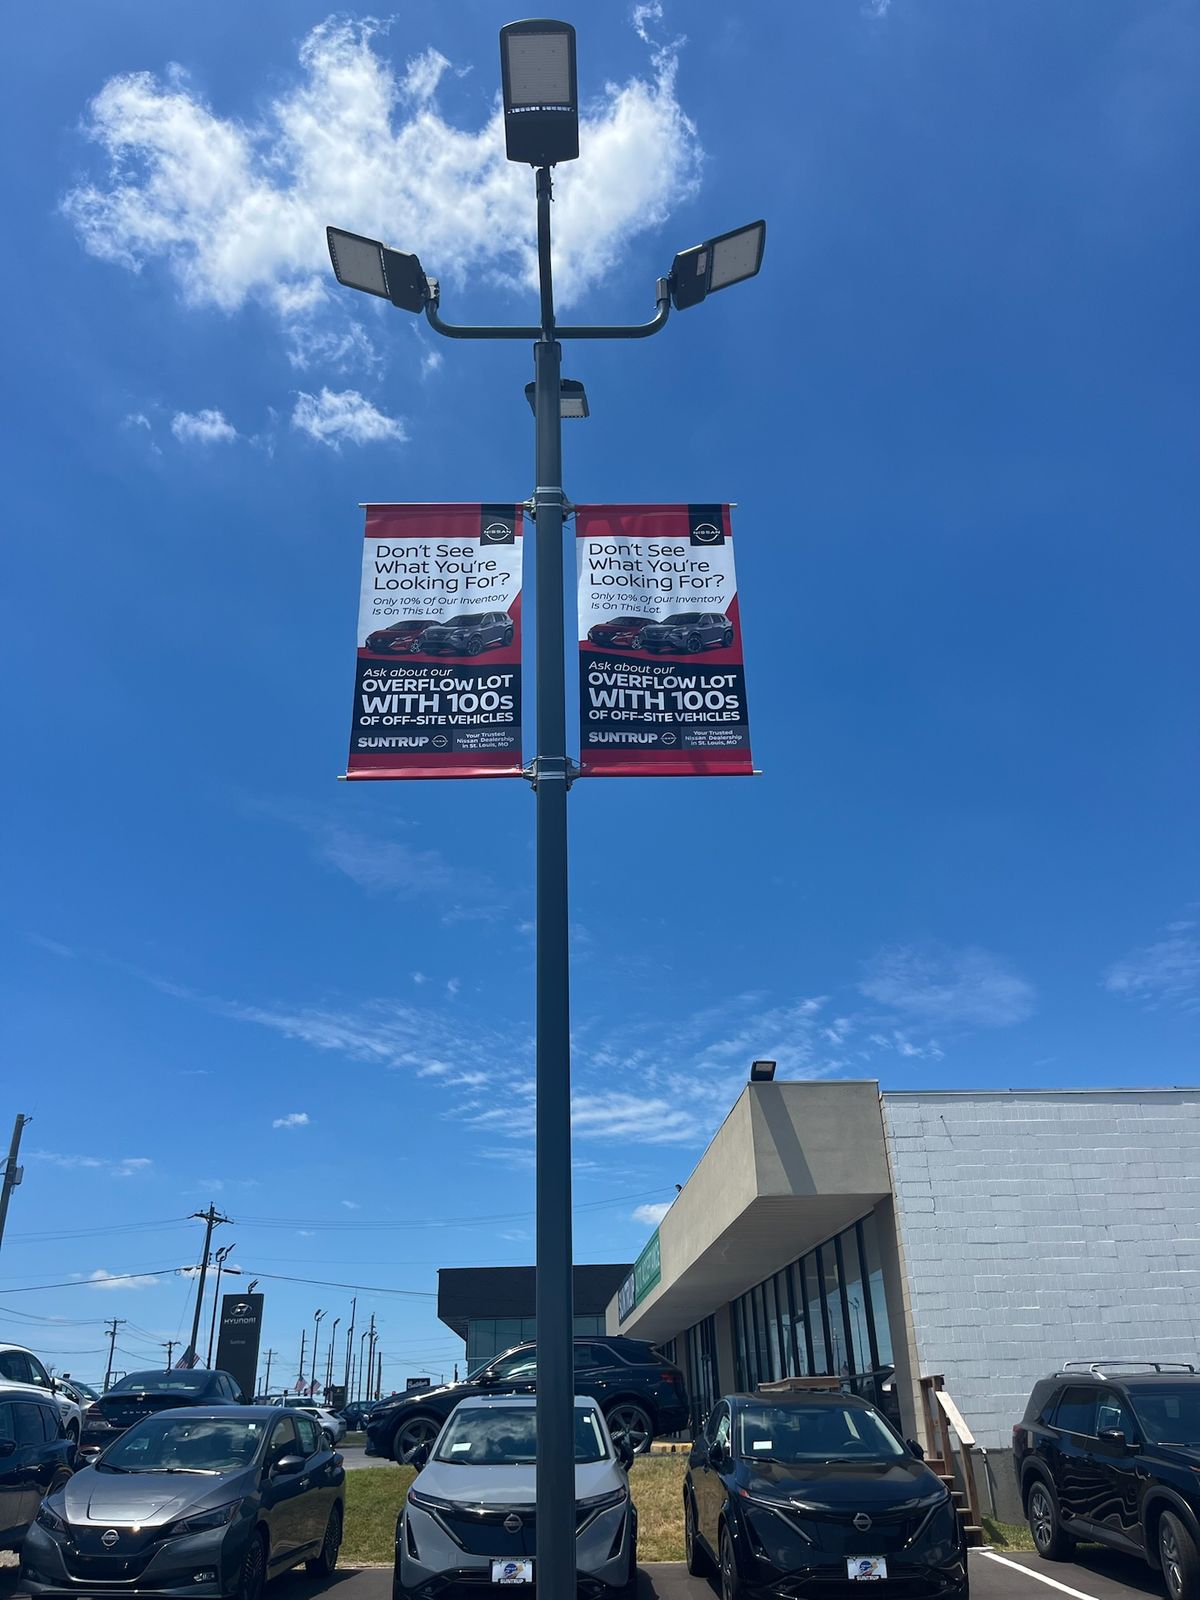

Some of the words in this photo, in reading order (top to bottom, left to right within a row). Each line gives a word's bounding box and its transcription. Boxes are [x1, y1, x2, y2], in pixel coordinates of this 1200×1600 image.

[376, 544, 430, 558] Don't
[437, 545, 473, 558] See
[589, 543, 642, 557] Don't
[648, 544, 684, 556] See
[375, 560, 429, 574] What
[435, 560, 496, 574] You're
[589, 558, 643, 572] What
[647, 559, 709, 572] You're
[374, 576, 458, 593] Looking
[466, 572, 510, 588] For?
[590, 573, 673, 591] Looking
[680, 574, 724, 588] For?
[373, 597, 398, 606] Only
[459, 593, 509, 605] Inventory
[591, 592, 616, 601] Only
[617, 593, 638, 601] 10%
[641, 594, 653, 602] Of
[676, 595, 724, 604] Inventory
[372, 607, 381, 615] Is
[402, 607, 424, 615] This
[621, 604, 641, 612] This
[643, 605, 662, 614] Lot.
[363, 668, 387, 677] Ask
[390, 667, 428, 677] about
[589, 661, 611, 670] Ask
[614, 662, 651, 674] about
[653, 666, 674, 674] our
[362, 678, 473, 692] OVERFLOW
[477, 674, 513, 689] LOT
[588, 672, 696, 689] OVERFLOW
[700, 675, 736, 688] LOT
[362, 694, 439, 713] WITH
[447, 691, 514, 713] 100s
[589, 687, 664, 710] WITH
[672, 691, 739, 710] 100s
[360, 716, 379, 726] OF
[382, 716, 446, 726] OFF-SITE
[449, 712, 514, 724] VEHICLES
[589, 709, 608, 720] OF
[611, 710, 673, 722] OFF-SITE
[675, 712, 740, 722] VEHICLES
[358, 736, 429, 748] SUNTRUP
[588, 732, 658, 744] SUNTRUP
